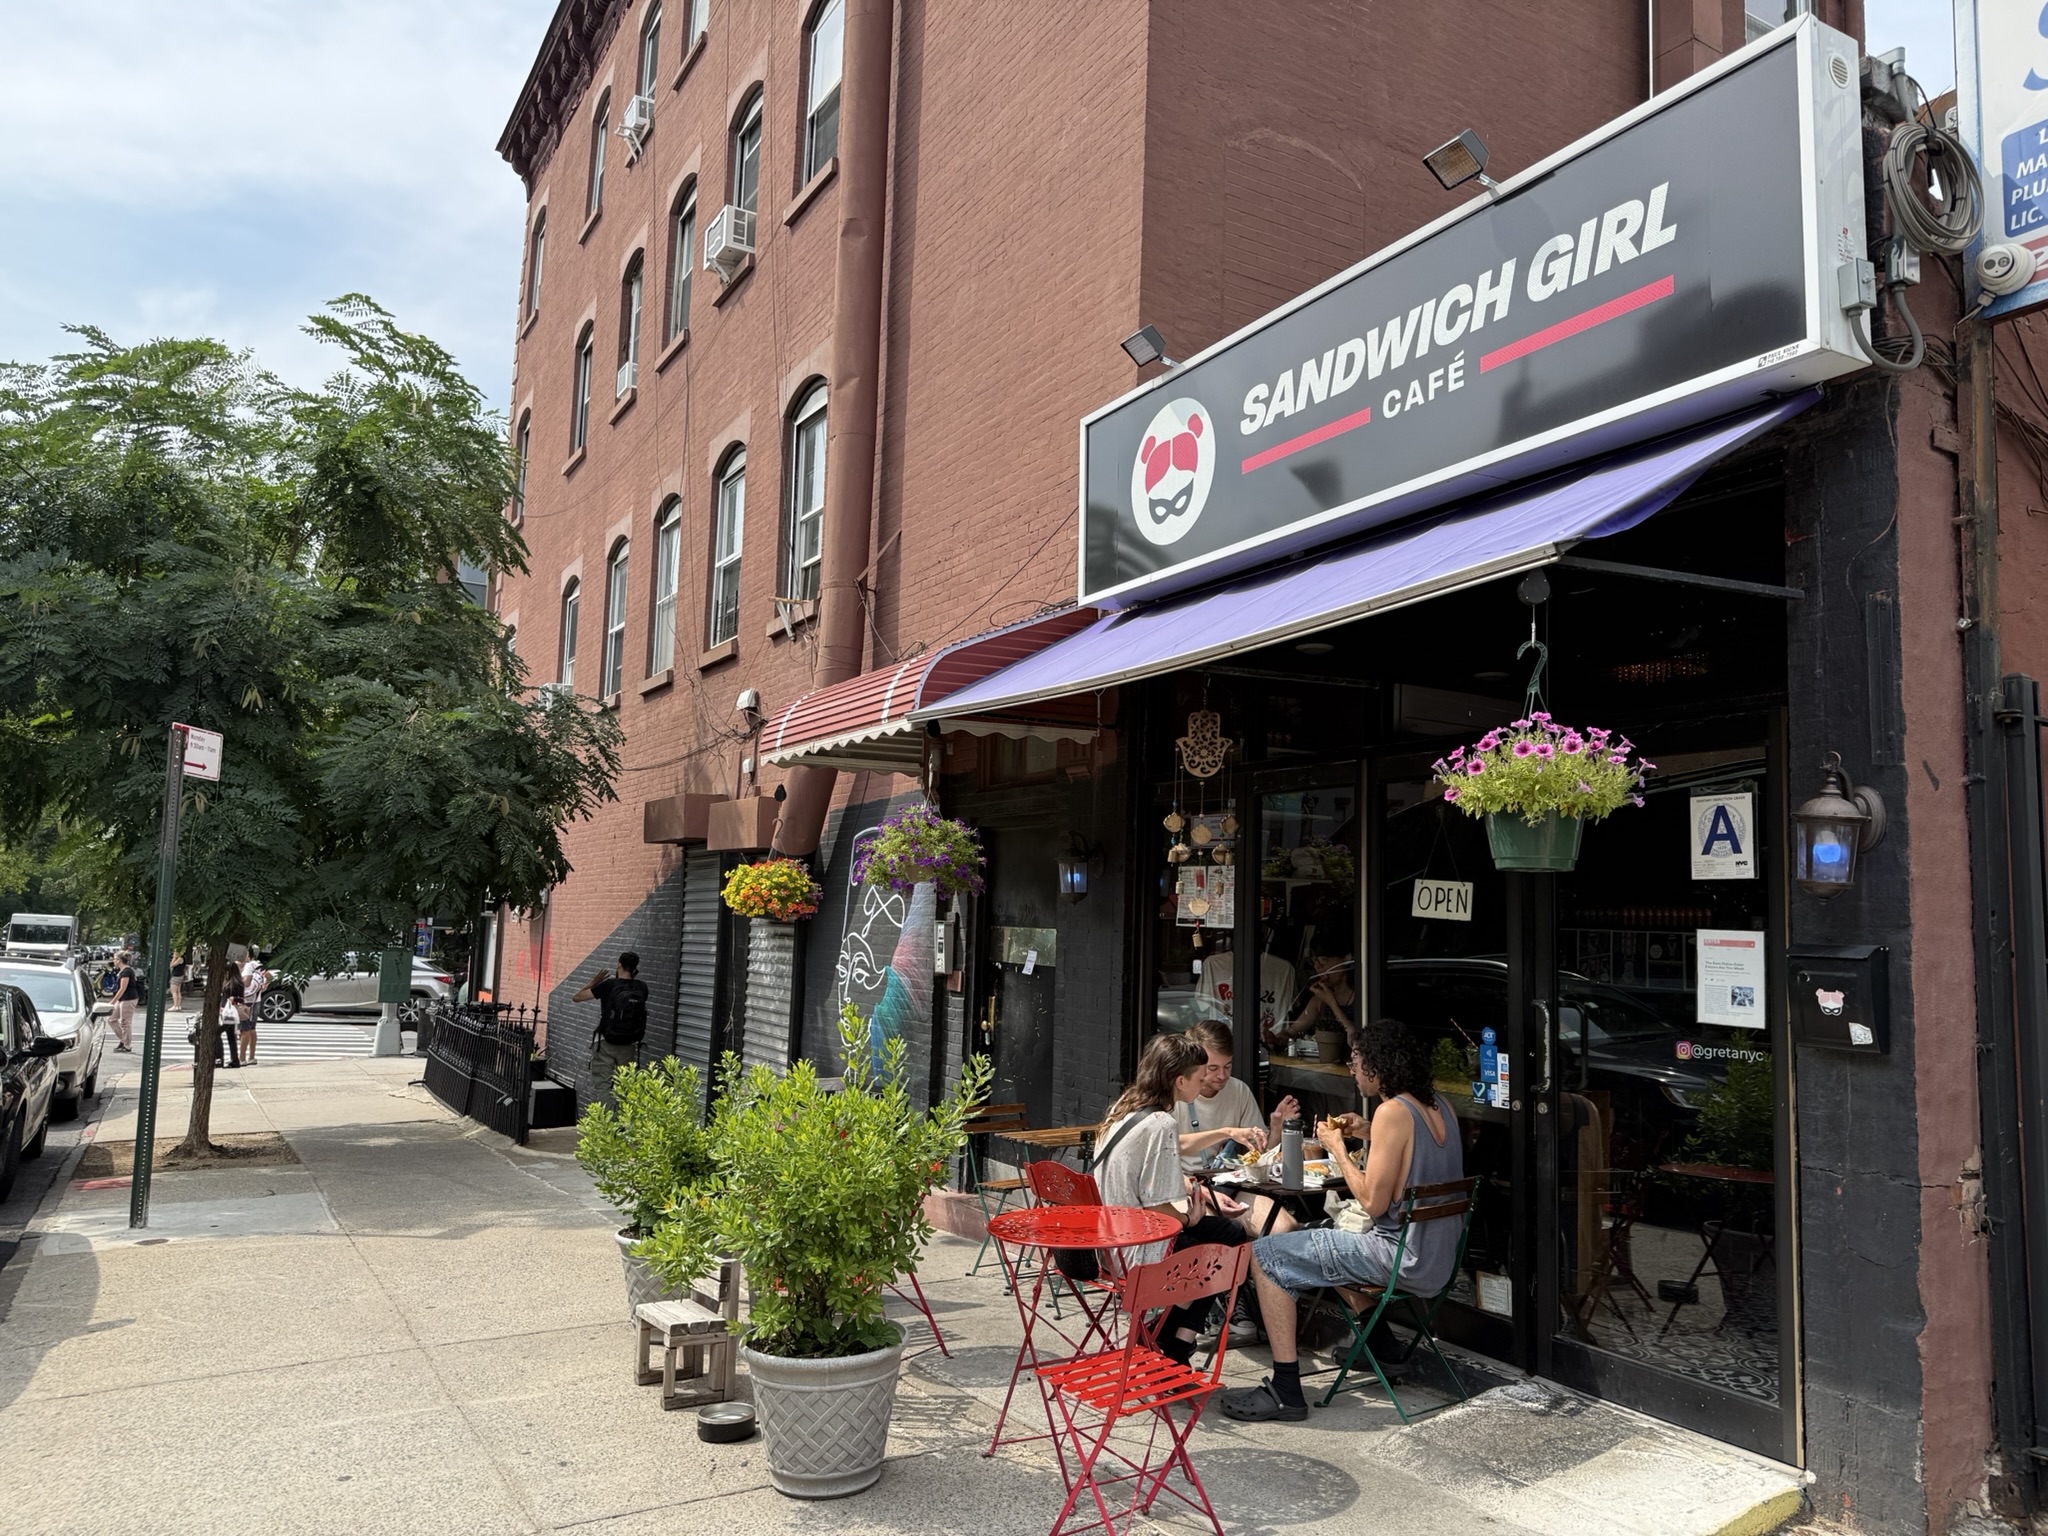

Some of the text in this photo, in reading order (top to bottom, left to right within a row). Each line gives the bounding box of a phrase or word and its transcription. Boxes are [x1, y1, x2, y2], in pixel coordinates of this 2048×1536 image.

[2010, 206, 2043, 230] LIC.
[1239, 181, 1678, 435] SANDWICH GIRL
[1382, 350, 1465, 419] CAFÉ
[190, 733, 205, 742] Monday
[1701, 805, 1743, 856] A
[1417, 886, 1468, 914] OPEN
[1691, 1044, 1764, 1063] @gretanyc
[1484, 1069, 1496, 1077] VISA
